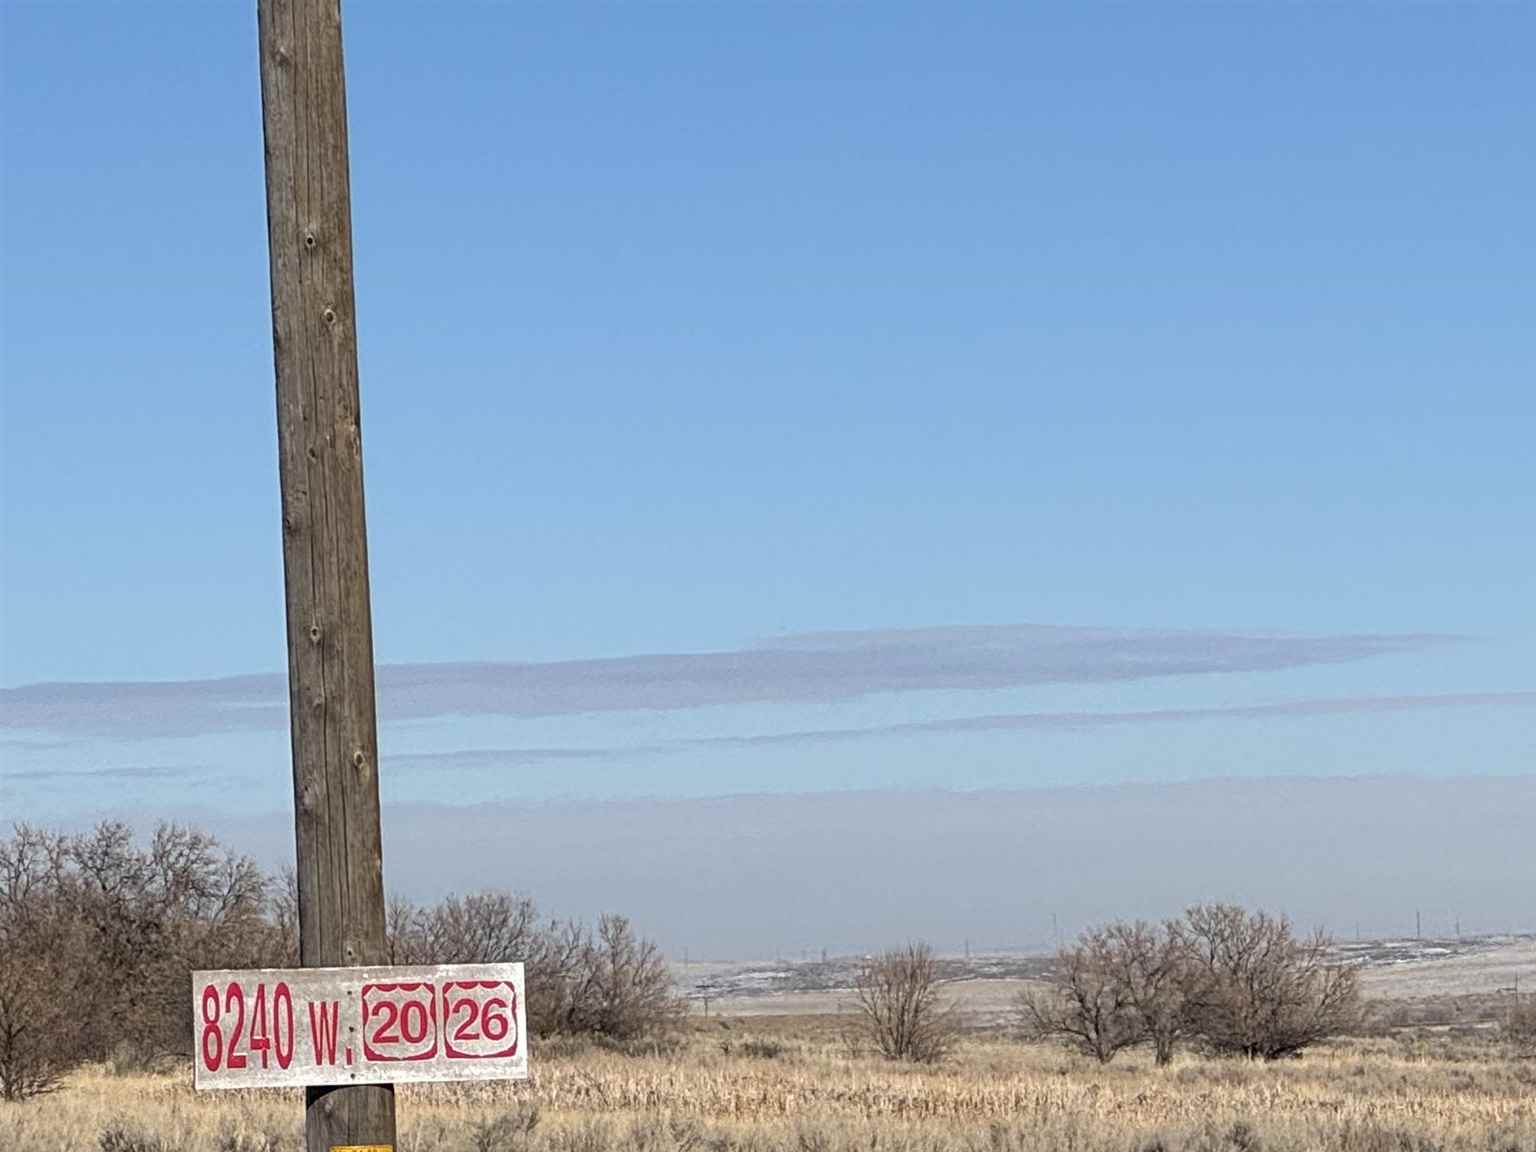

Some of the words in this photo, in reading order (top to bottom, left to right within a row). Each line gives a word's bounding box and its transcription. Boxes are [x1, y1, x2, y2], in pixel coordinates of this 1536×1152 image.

[202, 982, 294, 1072] 8240
[309, 1001, 353, 1065] W.
[371, 1000, 428, 1044] 20
[452, 998, 509, 1041] 26
